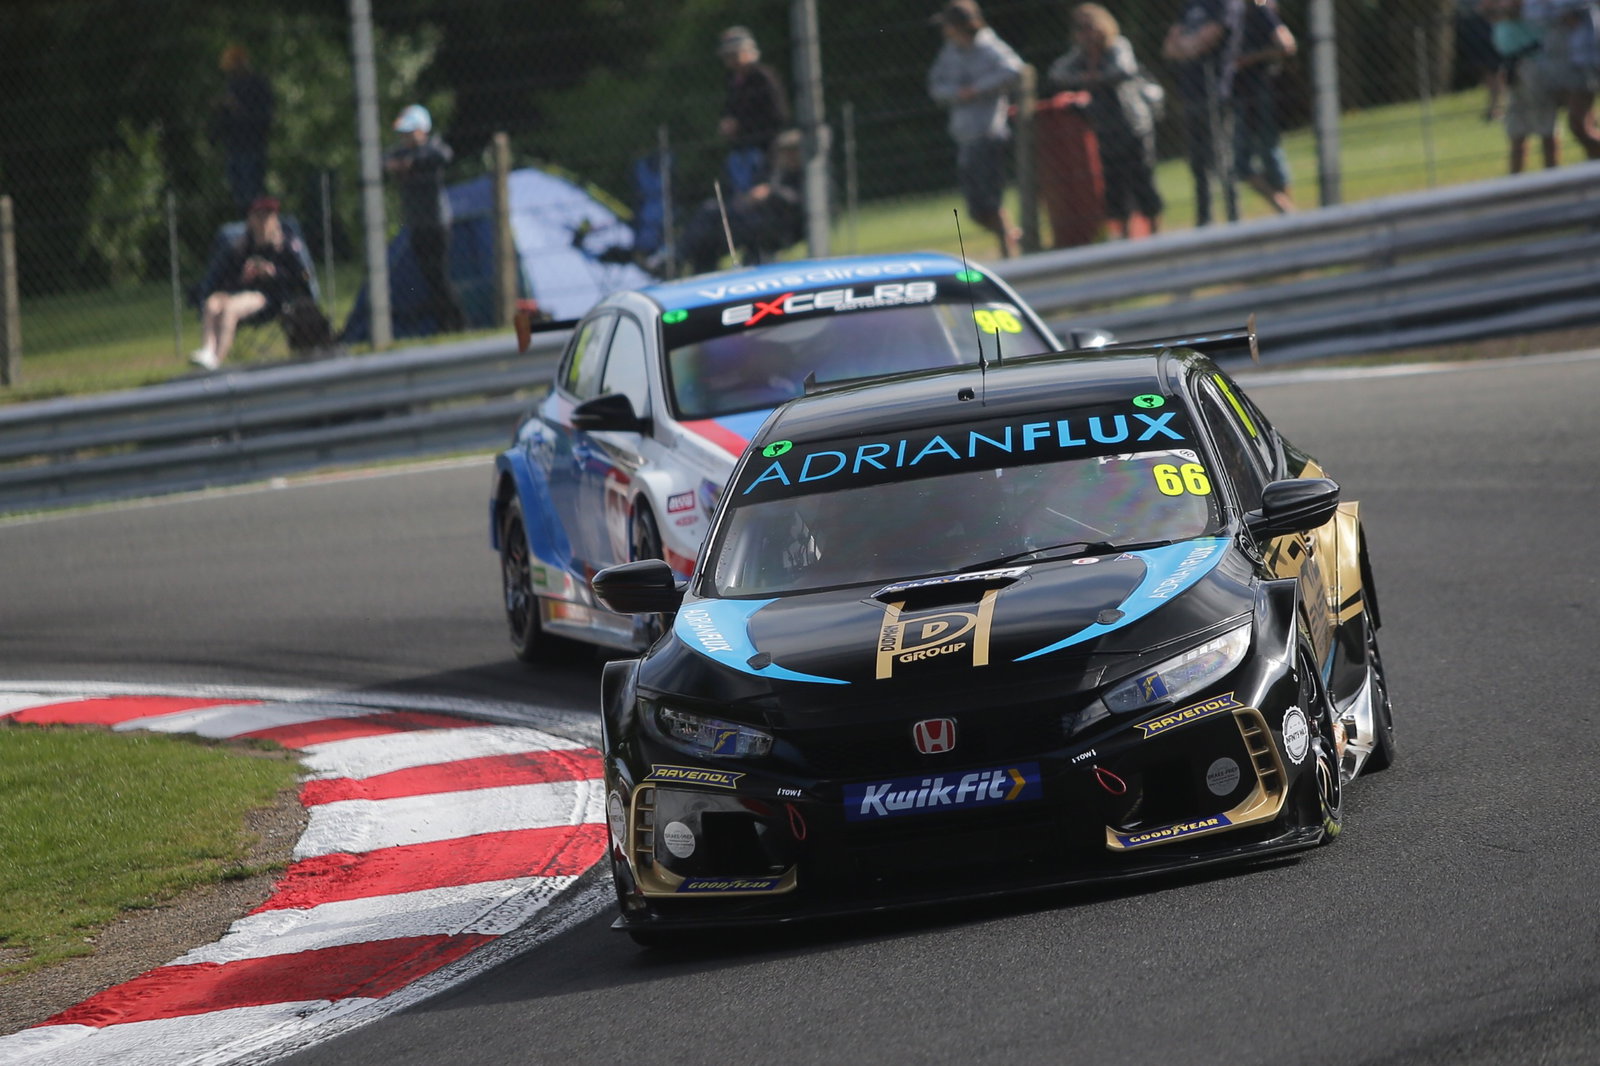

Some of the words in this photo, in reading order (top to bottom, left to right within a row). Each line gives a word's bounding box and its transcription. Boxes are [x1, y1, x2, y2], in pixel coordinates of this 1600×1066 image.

[722, 282, 936, 326] EXCELR8
[1153, 463, 1212, 496] 66
[900, 642, 966, 663] GROUP
[1148, 699, 1231, 731] RAVENOL
[1077, 751, 1092, 761] TOW
[655, 768, 730, 783] RAVENOL
[1129, 818, 1219, 843] GOODYEAR
[688, 880, 771, 890] GOODYEAR
